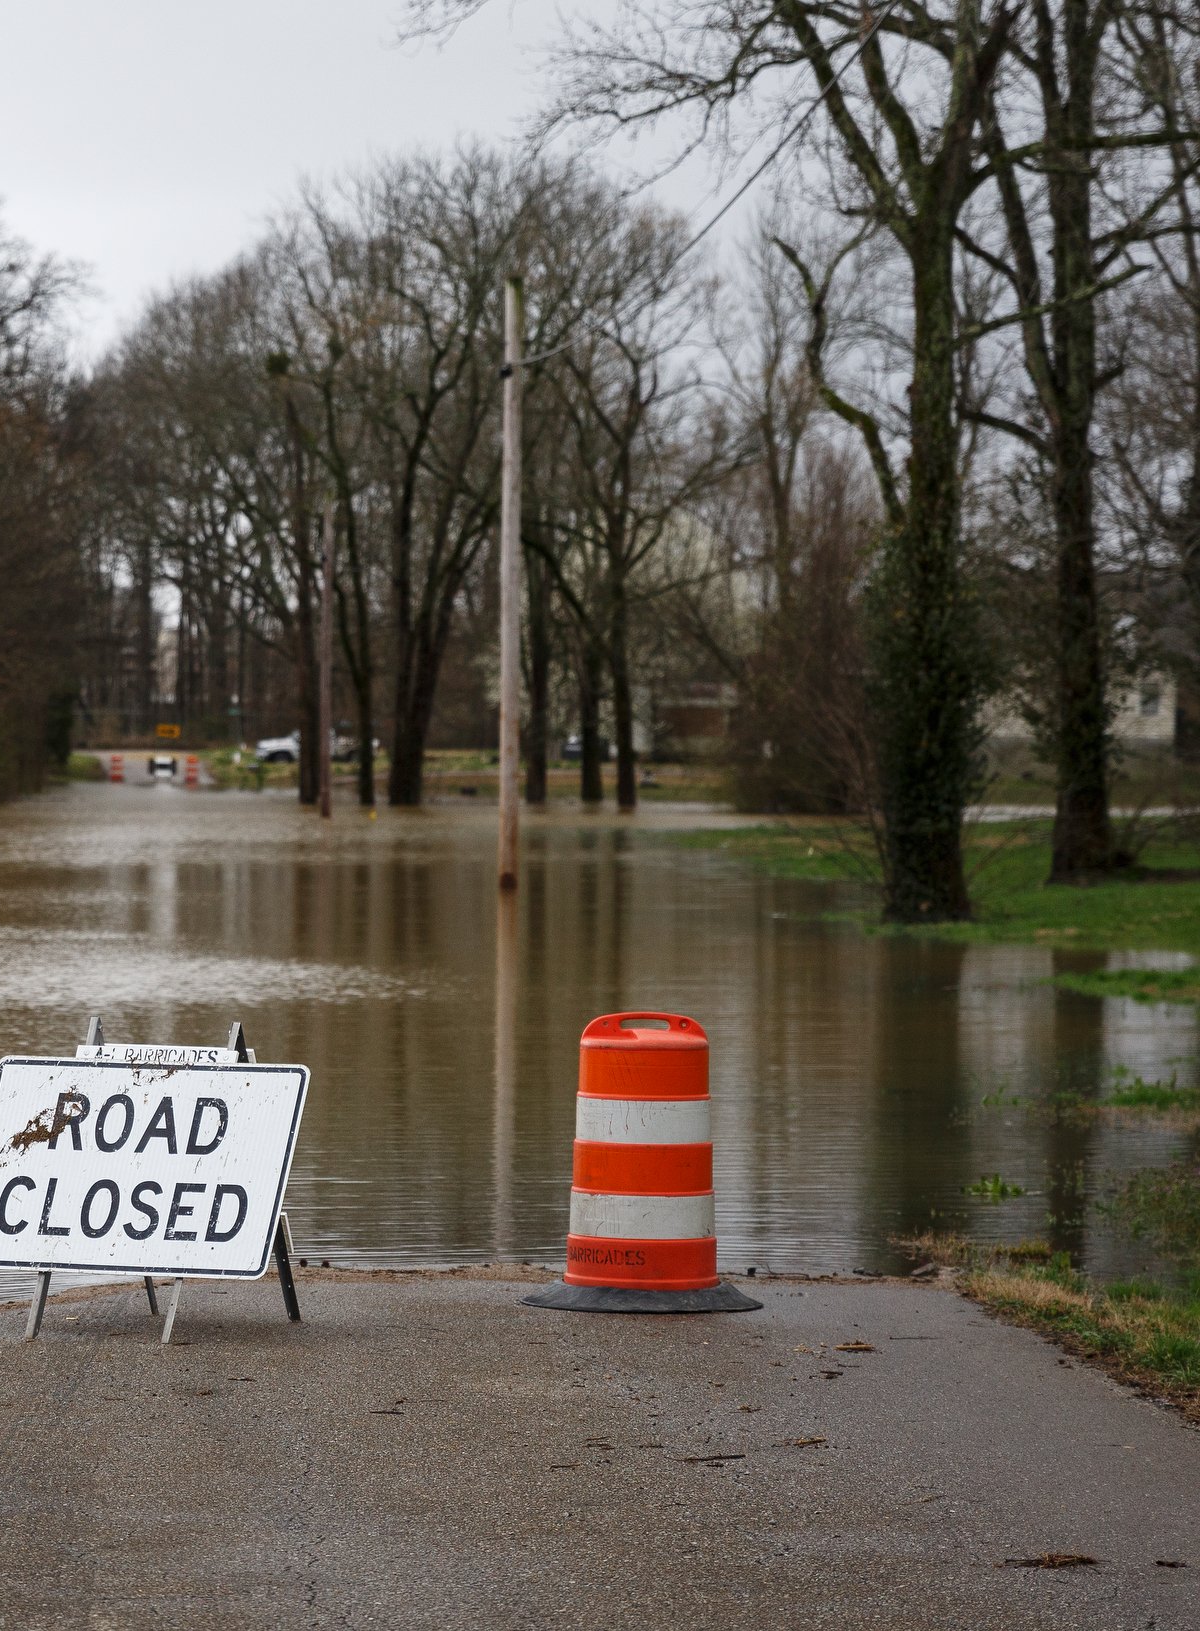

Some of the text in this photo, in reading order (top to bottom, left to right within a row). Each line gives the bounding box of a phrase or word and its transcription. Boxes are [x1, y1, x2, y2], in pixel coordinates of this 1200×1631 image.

[124, 1048, 218, 1063] BARRICADES
[48, 1092, 229, 1155] ROAD
[568, 1246, 646, 1266] BARRICADES
